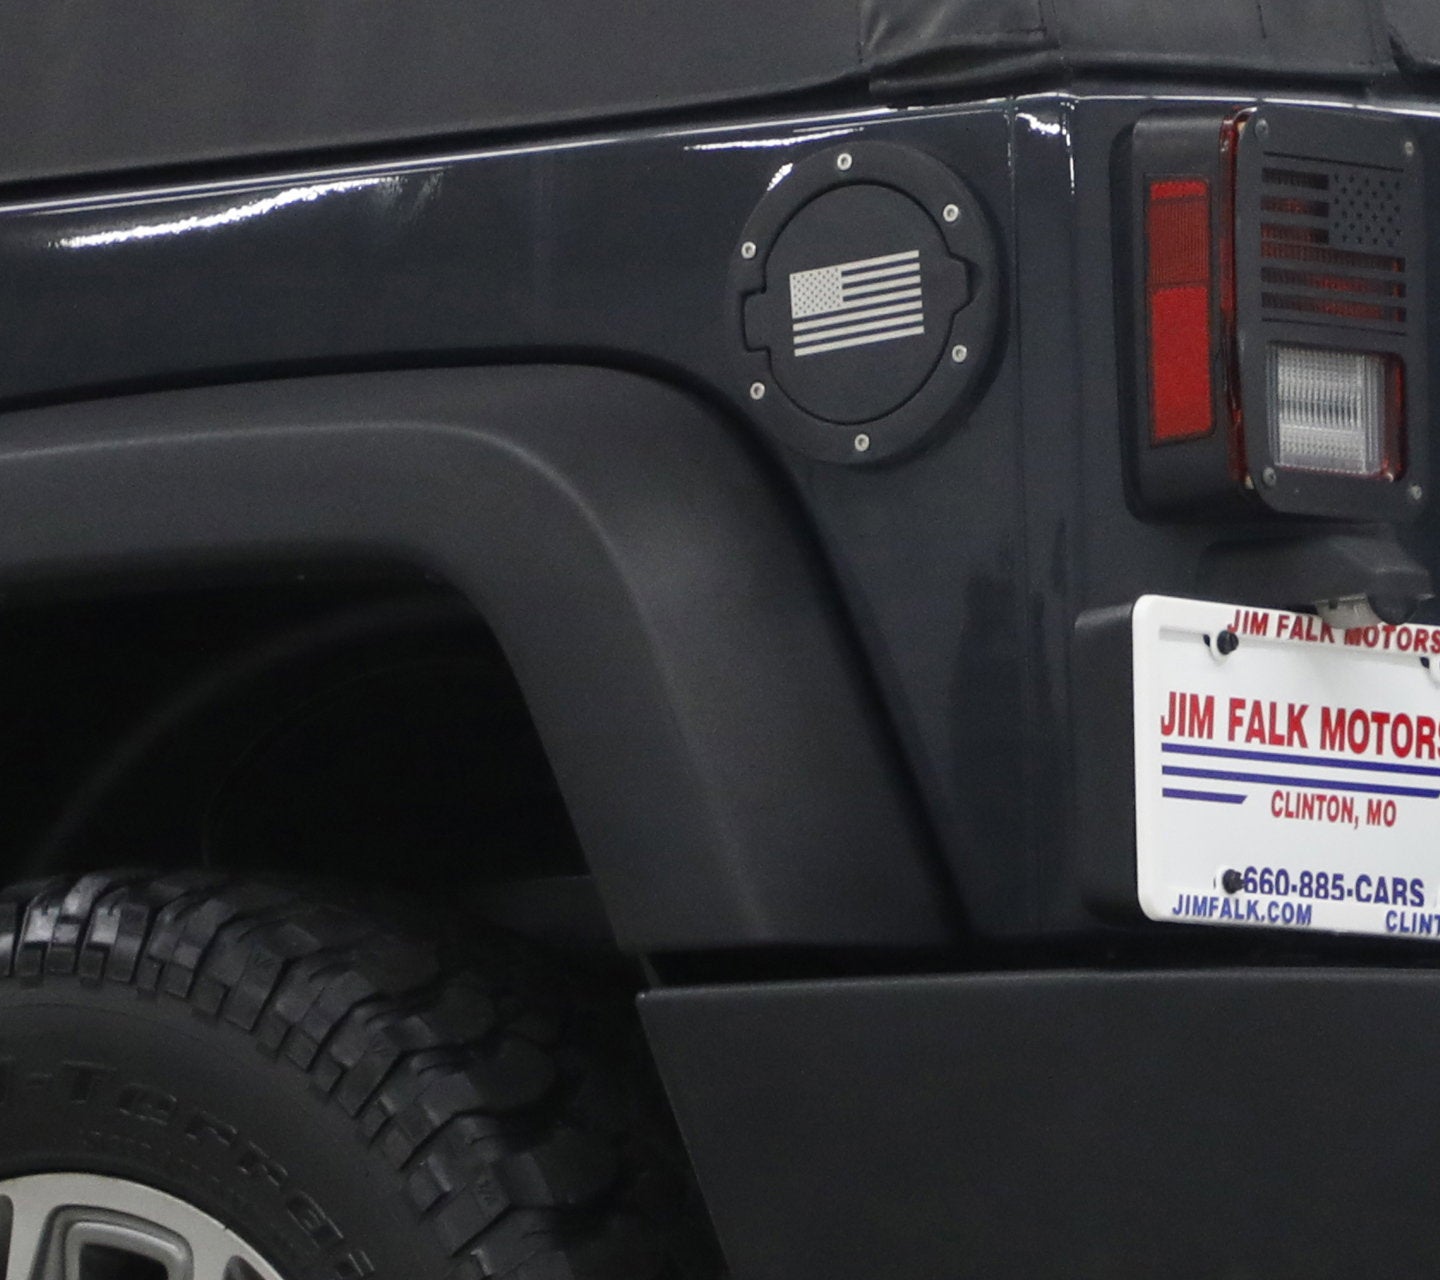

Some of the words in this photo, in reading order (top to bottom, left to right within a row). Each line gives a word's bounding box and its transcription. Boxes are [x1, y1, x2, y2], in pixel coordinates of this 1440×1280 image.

[1227, 609, 1270, 636] JIM
[1276, 614, 1335, 644] FALK
[1160, 691, 1215, 740] JIM
[1227, 697, 1310, 749] FALK
[1270, 790, 1359, 830] CLINTON,
[1366, 799, 1397, 828] MO
[1243, 866, 1426, 907] 660-885-CARS
[1172, 894, 1313, 926] JIMFALK.COM
